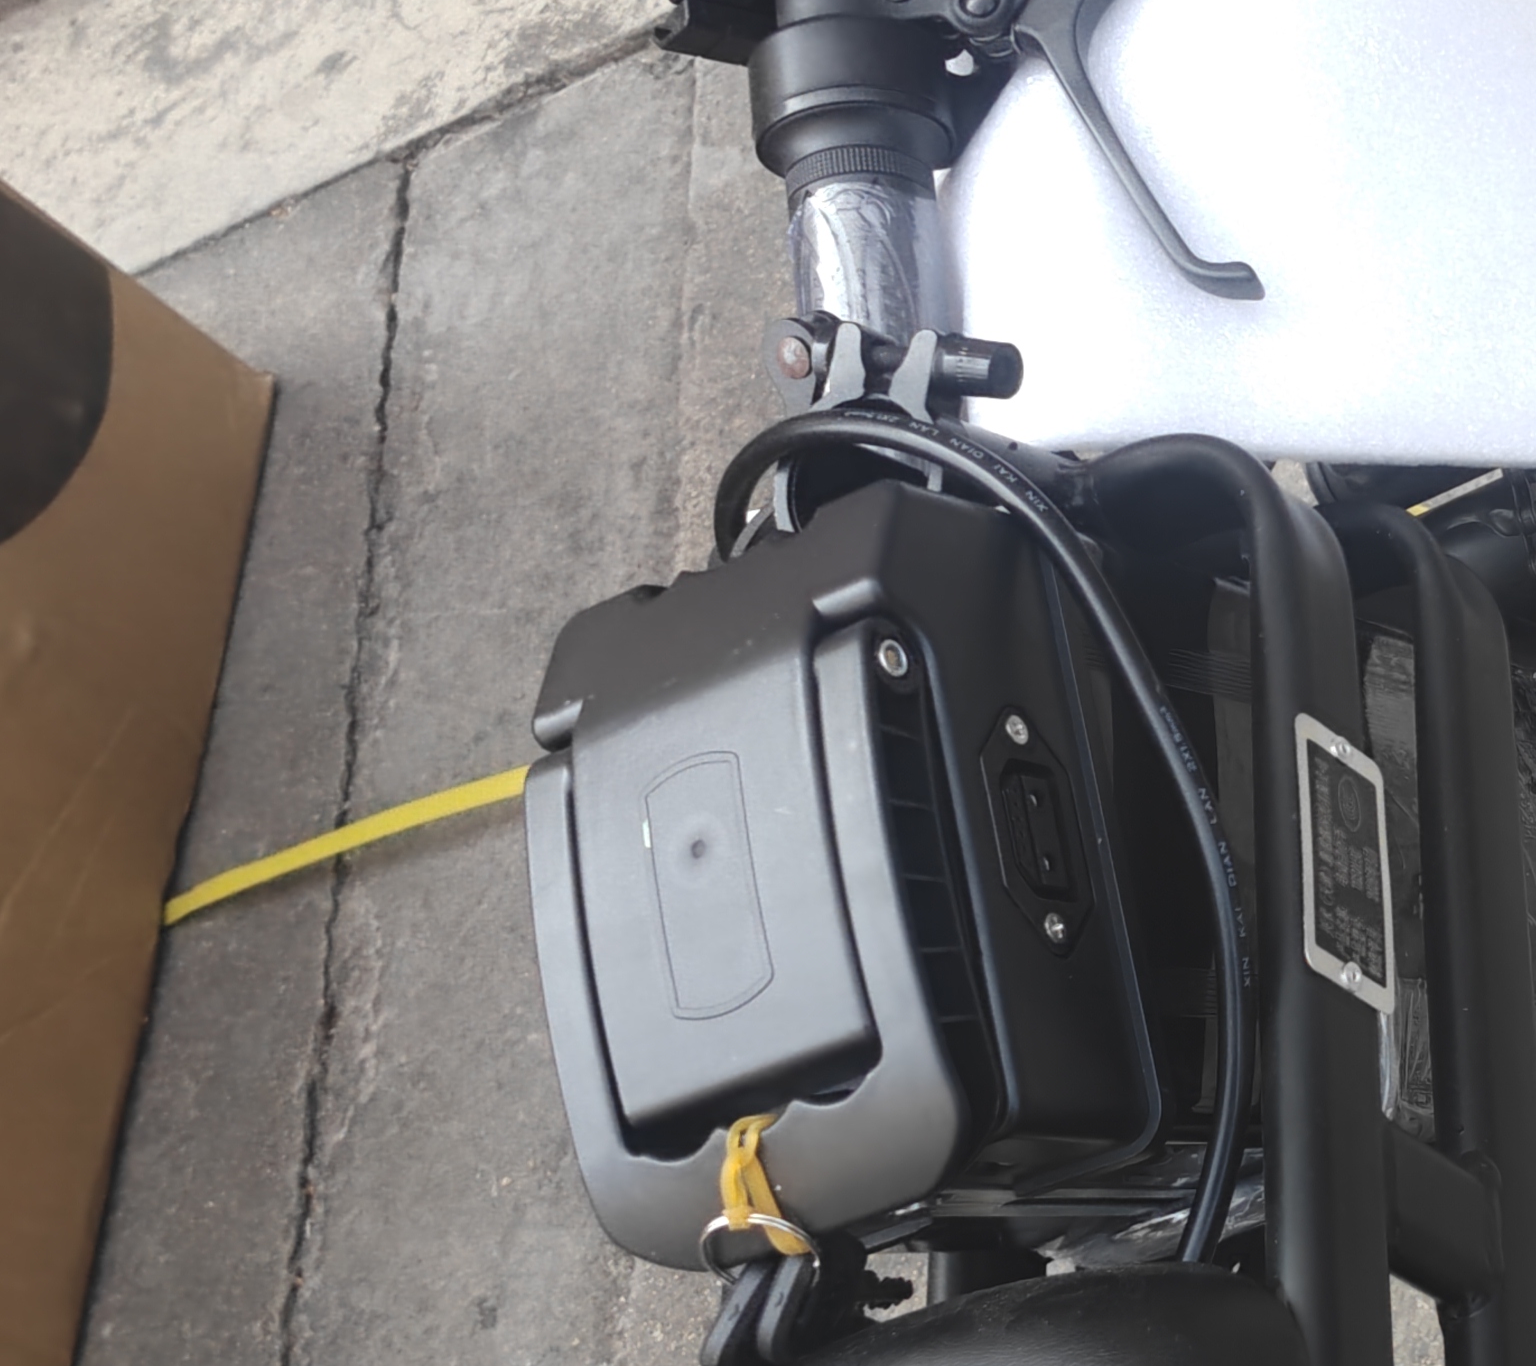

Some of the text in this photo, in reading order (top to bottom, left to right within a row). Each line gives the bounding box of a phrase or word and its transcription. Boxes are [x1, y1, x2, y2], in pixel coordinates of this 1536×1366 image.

[908, 421, 940, 437] LAN
[994, 463, 1017, 484] KAI
[1025, 490, 1048, 512] XIN
[1198, 787, 1218, 825] LAN
[1235, 908, 1246, 938] KAI
[1241, 957, 1250, 987] XIN
